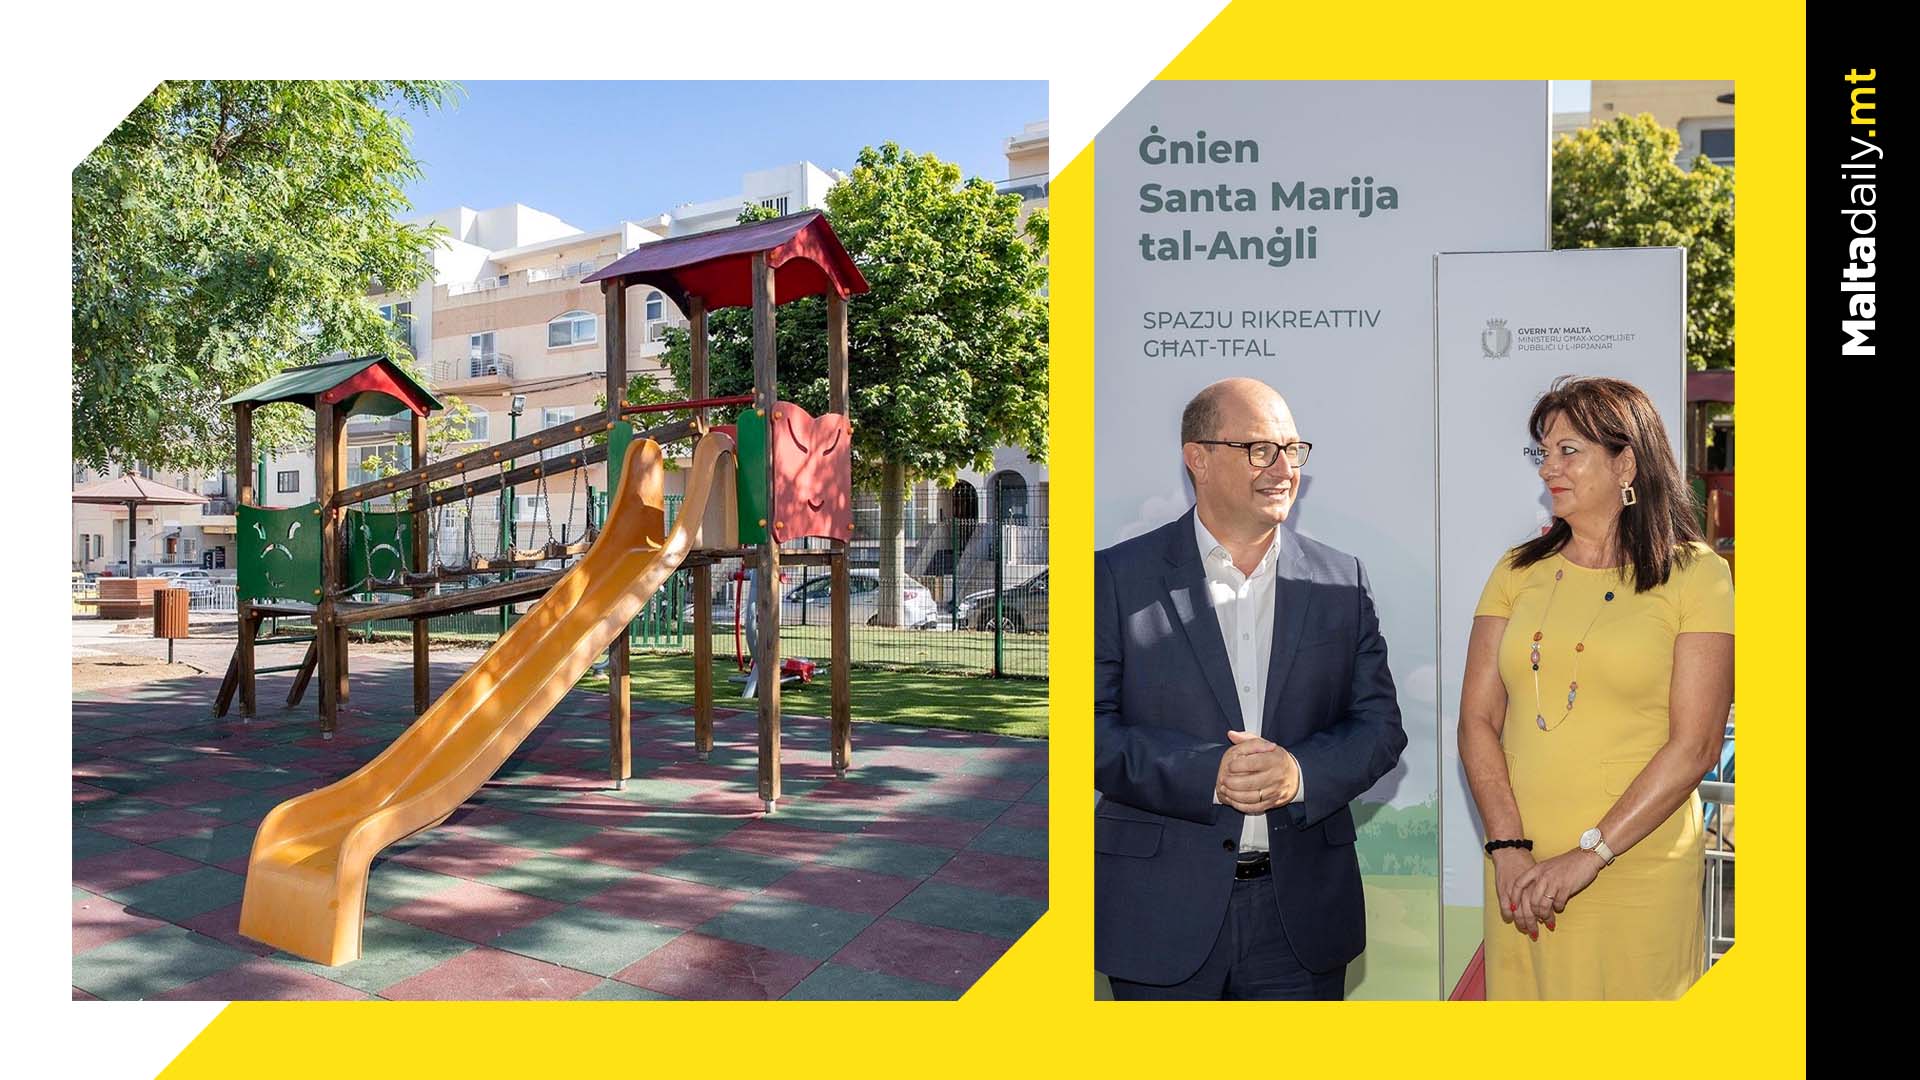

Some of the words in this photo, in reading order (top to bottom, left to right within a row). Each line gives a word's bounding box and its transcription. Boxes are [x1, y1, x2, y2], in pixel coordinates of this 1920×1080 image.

[1138, 125, 1260, 165] Ġnien
[1139, 183, 1257, 214] Santa
[1271, 176, 1399, 218] Marija
[1138, 225, 1317, 268] tal-Anġli
[1143, 311, 1233, 330] SPAZJU
[1242, 309, 1381, 329] RIKREATTIV
[1143, 338, 1276, 358] GĦAT-TFAL
